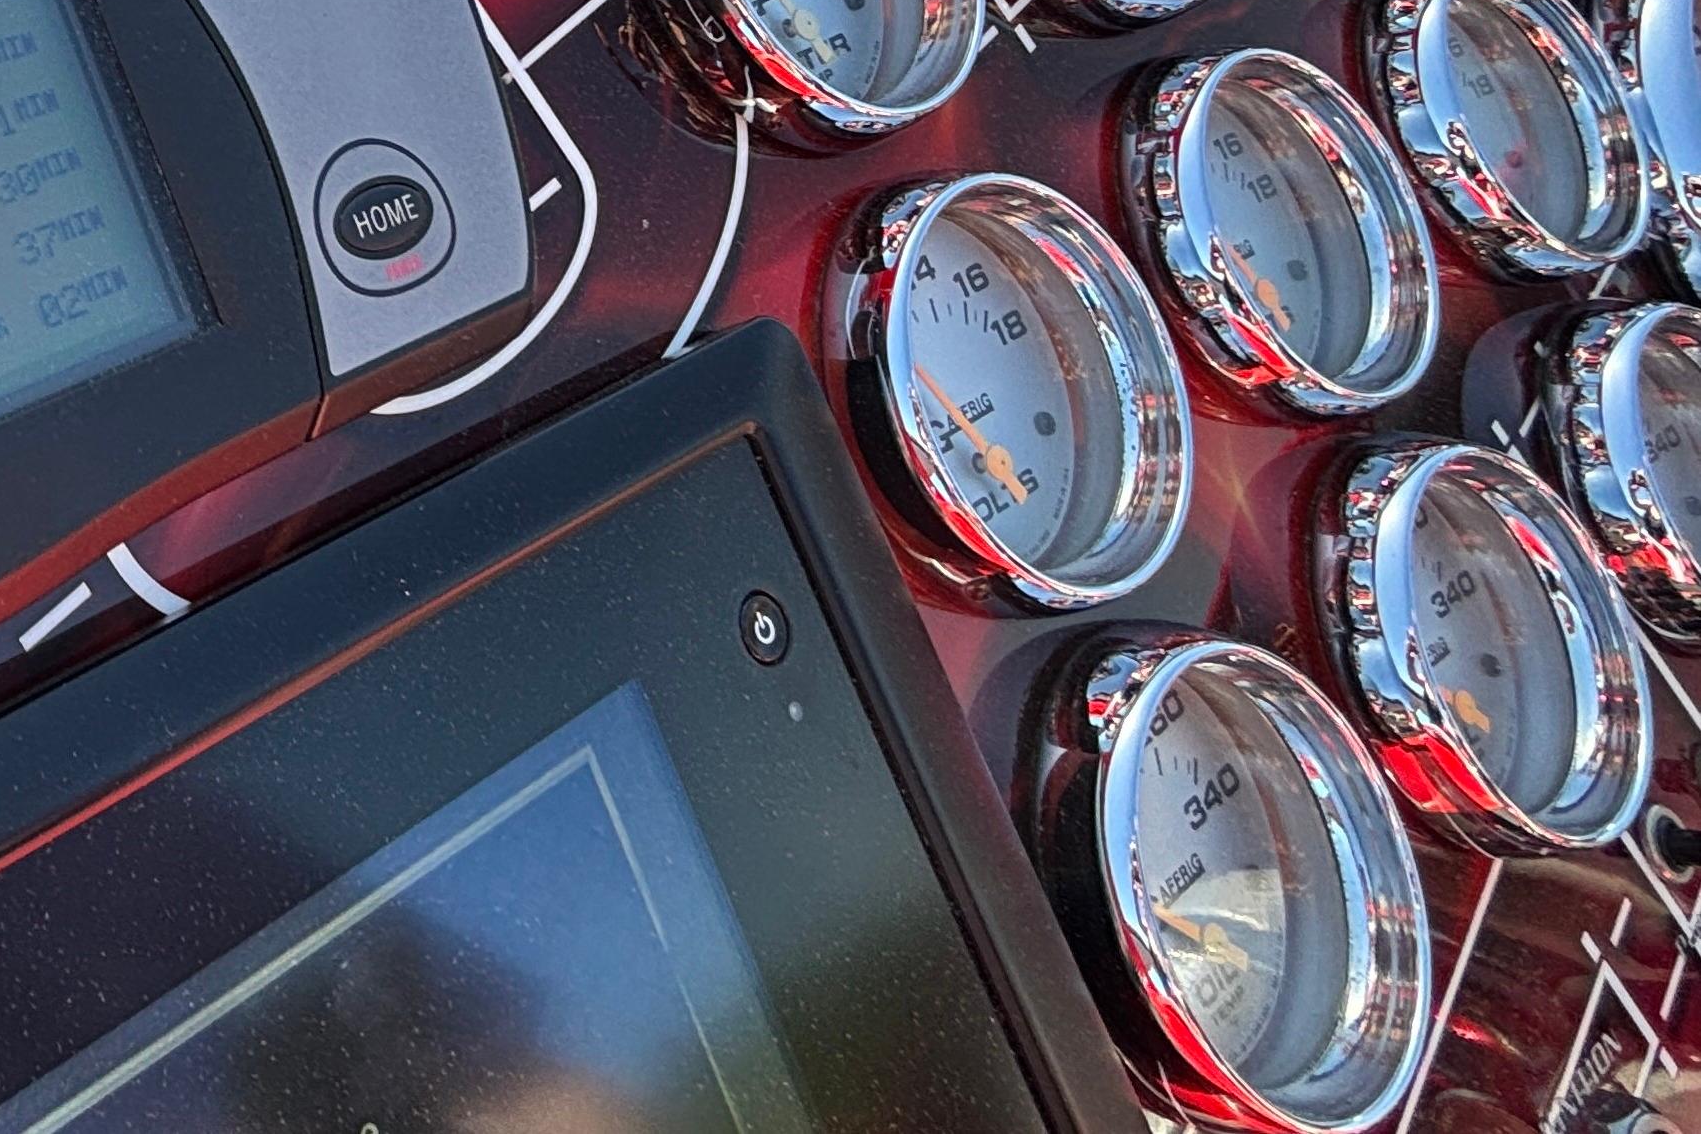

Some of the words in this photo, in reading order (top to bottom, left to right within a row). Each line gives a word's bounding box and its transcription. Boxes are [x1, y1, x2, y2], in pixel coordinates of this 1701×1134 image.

[1448, 37, 1465, 58] 6
[1467, 72, 1495, 99] 18
[1213, 132, 1244, 160] 16
[1247, 173, 1278, 203] 18
[13, 205, 105, 267] 37MIN
[353, 194, 420, 239] HOME
[911, 255, 936, 291] 4
[952, 262, 990, 298] 16
[37, 264, 130, 329] 02MIN
[990, 309, 1028, 345] 18
[972, 468, 1039, 524] OLS
[1431, 569, 1475, 619] 340
[1184, 762, 1240, 831] 340
[1194, 961, 1240, 1009] OIL
